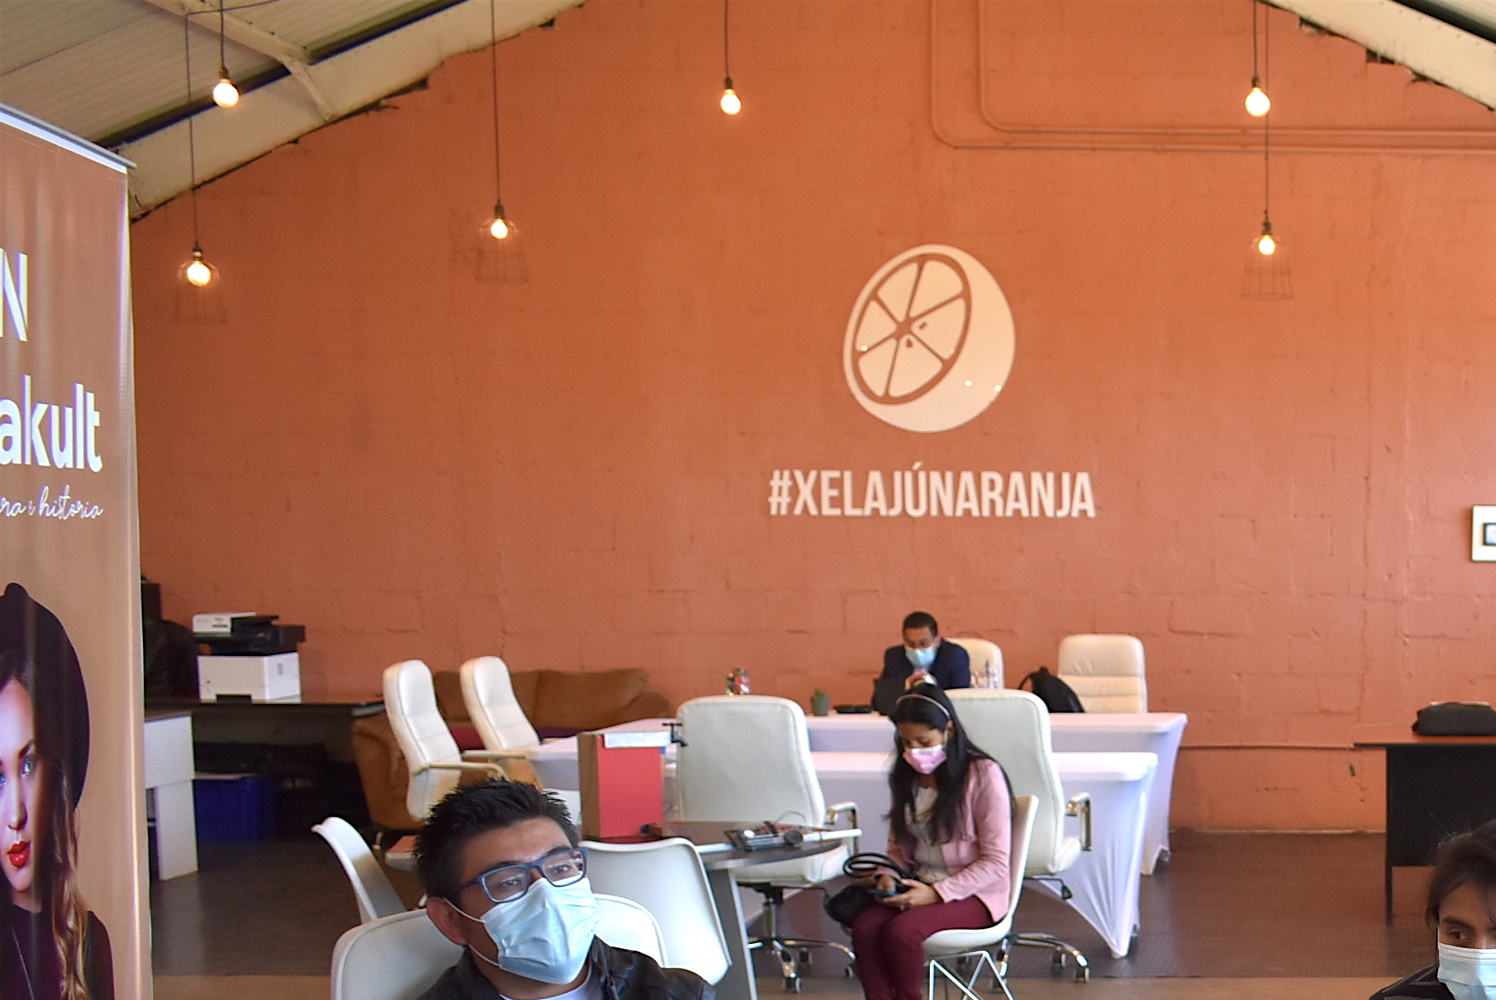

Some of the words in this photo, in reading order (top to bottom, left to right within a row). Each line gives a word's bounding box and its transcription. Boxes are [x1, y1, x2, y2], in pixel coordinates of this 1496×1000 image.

[0, 373, 103, 472] akult
[38, 484, 104, 520] historia
[768, 461, 1097, 518] #XELAJÚNARANJA
